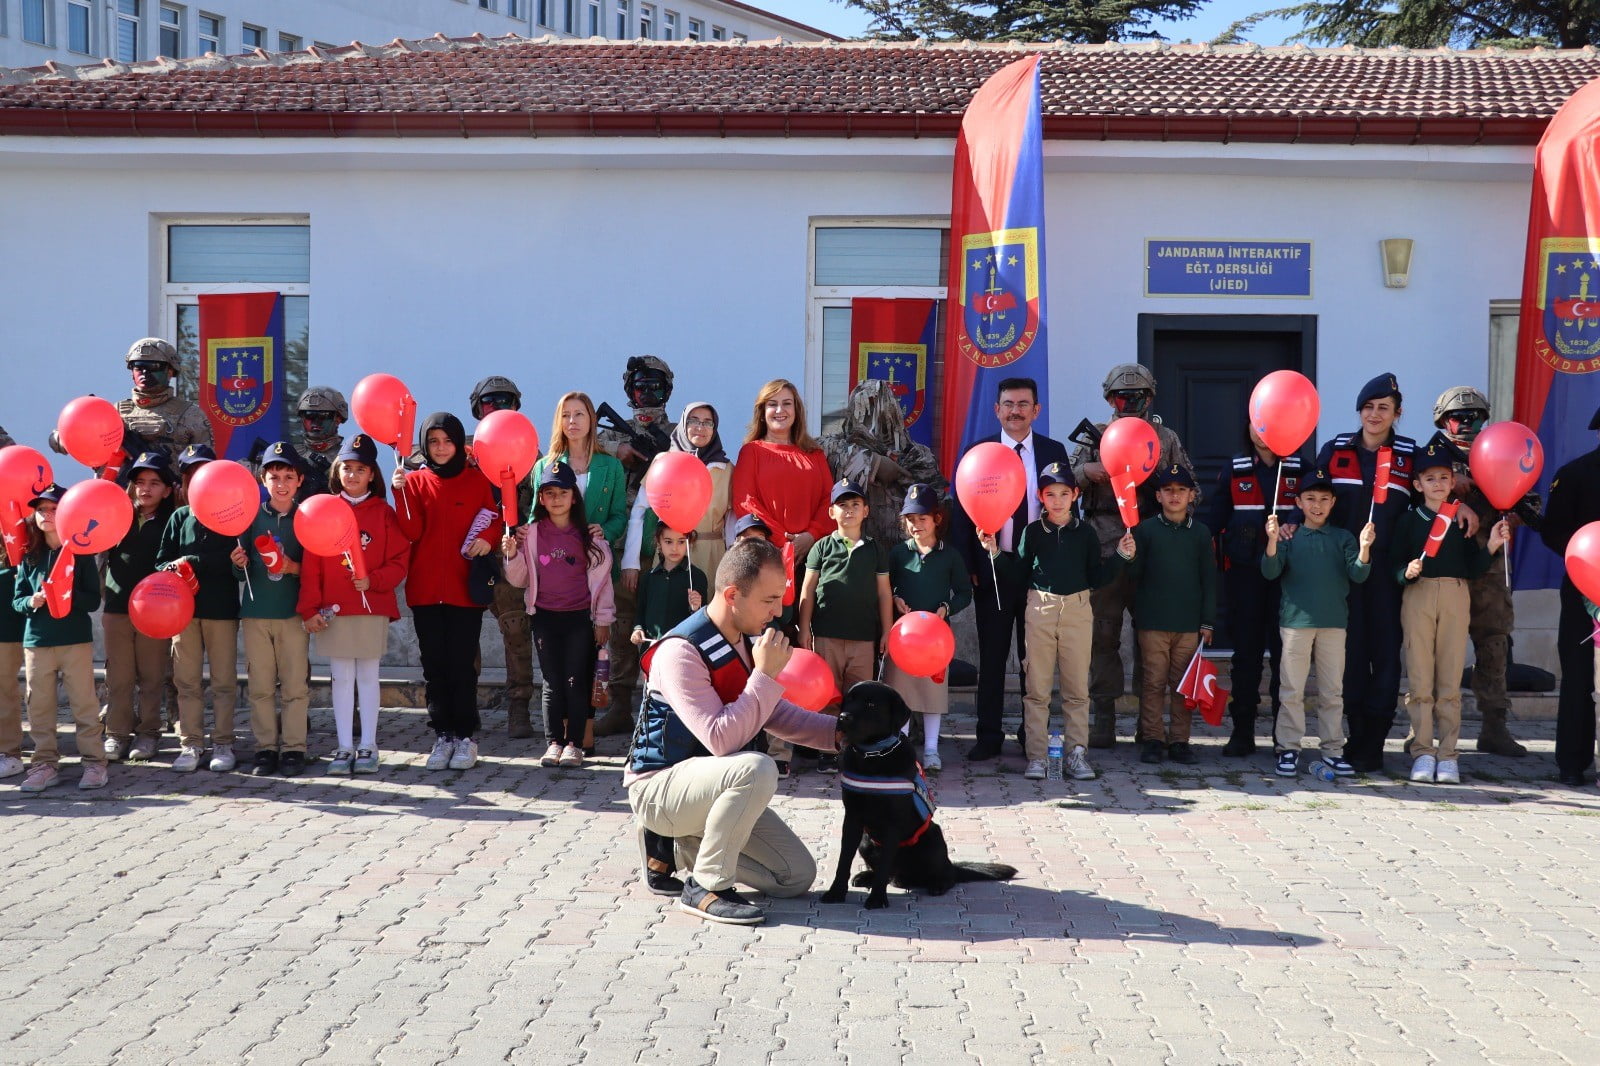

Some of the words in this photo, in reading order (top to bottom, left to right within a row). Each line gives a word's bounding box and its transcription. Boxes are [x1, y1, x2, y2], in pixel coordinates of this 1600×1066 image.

[1157, 247, 1225, 258] JANDARMA
[1228, 245, 1302, 259] İNTERAKTİF
[1186, 260, 1213, 274] EĞT.
[1216, 261, 1273, 275] DERSLİĞİ
[1209, 277, 1249, 291] (JİED)
[958, 331, 1034, 365] JANDARMA
[211, 402, 269, 424] JANDARMA
